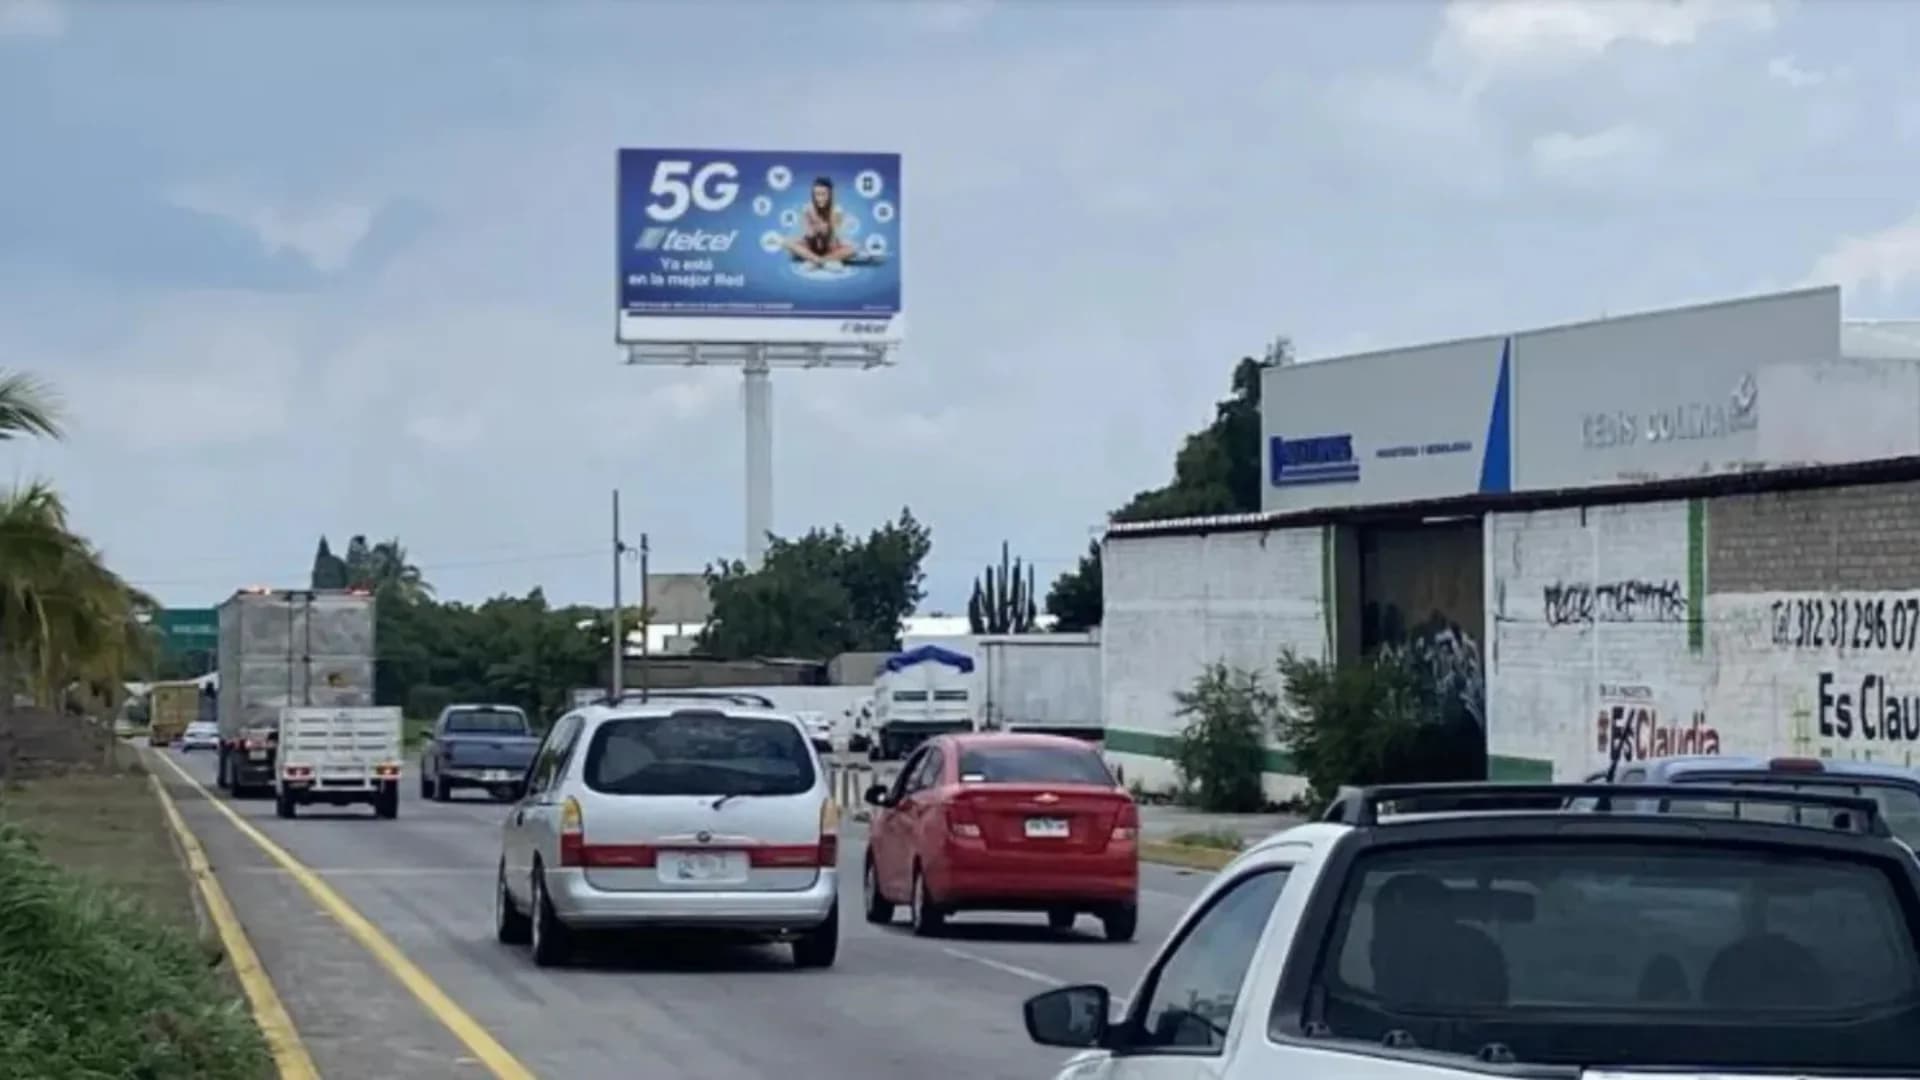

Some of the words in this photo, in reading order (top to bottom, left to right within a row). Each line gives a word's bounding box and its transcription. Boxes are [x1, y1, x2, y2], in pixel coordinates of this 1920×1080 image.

[645, 160, 739, 222] 5G
[661, 228, 739, 251] telcel
[660, 257, 680, 271] Ya
[628, 274, 647, 287] en
[650, 272, 664, 287] la
[667, 273, 710, 289] mejor
[714, 273, 744, 288] Red
[1891, 599, 1919, 651] 07
